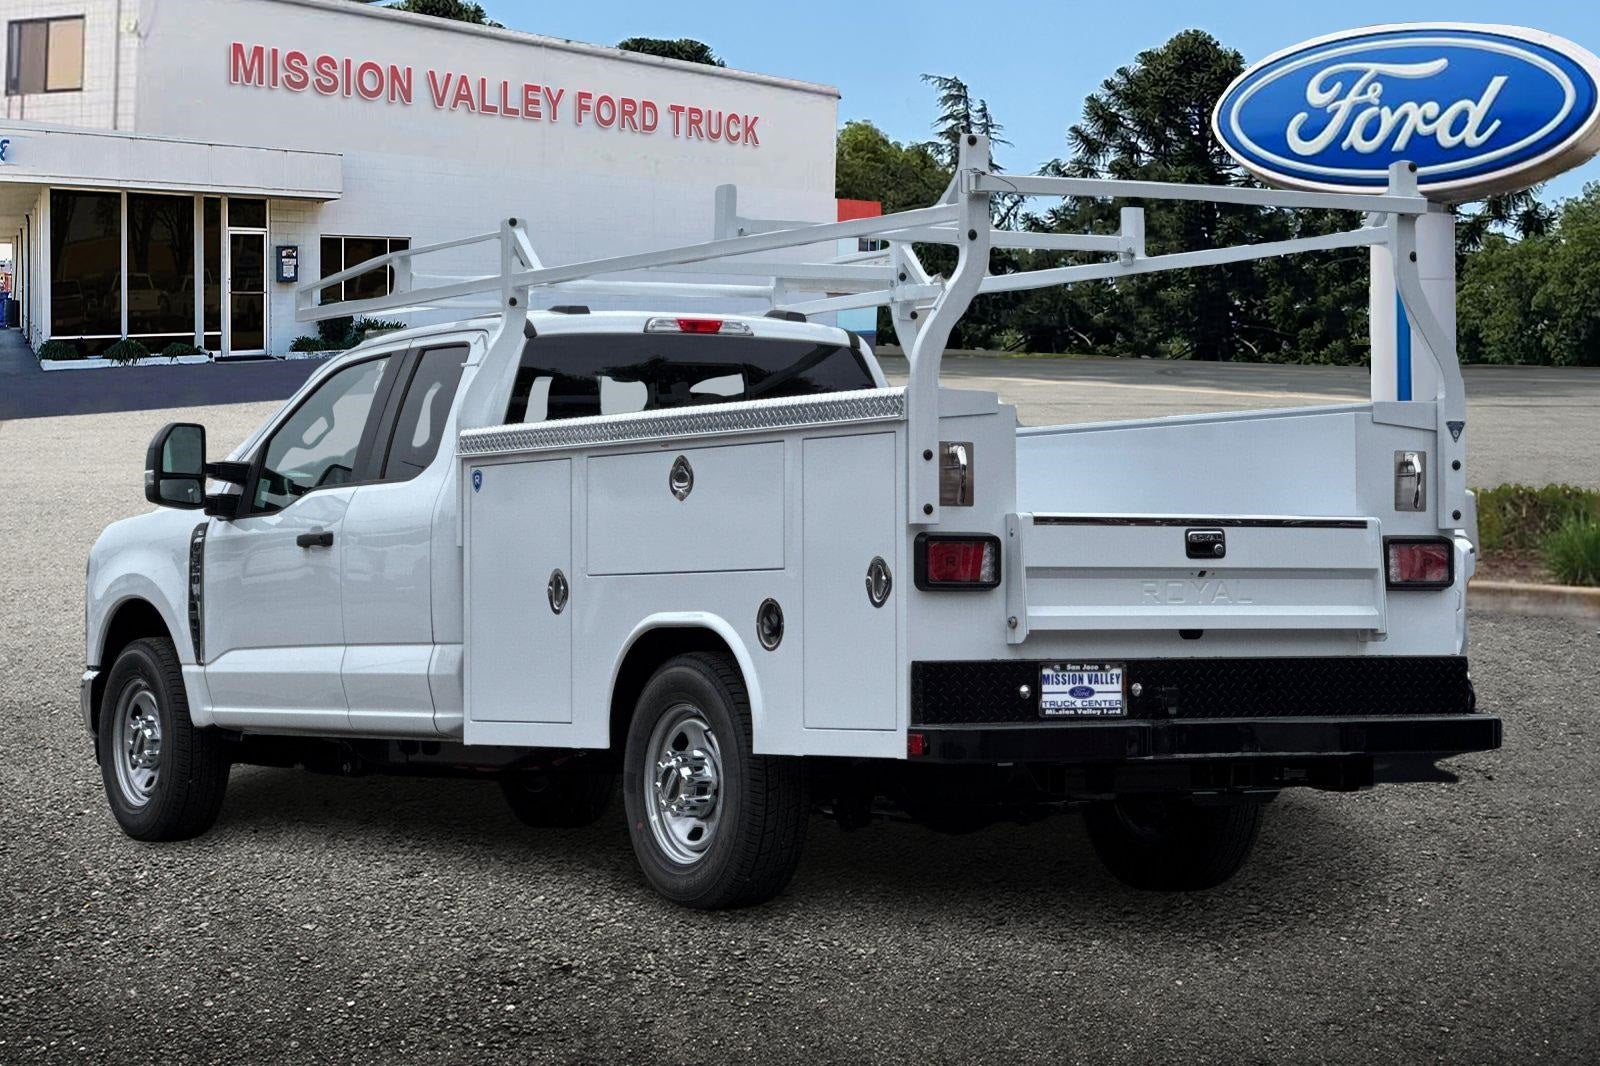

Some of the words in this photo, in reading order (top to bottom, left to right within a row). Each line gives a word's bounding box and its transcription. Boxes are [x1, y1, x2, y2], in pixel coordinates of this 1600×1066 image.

[229, 42, 413, 104] MISSION
[427, 70, 564, 122] VALLEY
[575, 91, 659, 134] FORD
[668, 104, 761, 147] TRUCK
[1286, 57, 1509, 156] Ford
[1140, 580, 1253, 604] ROYAL
[1042, 673, 1084, 685] MISSION
[1087, 673, 1121, 685] VALLEY
[1044, 700, 1077, 708] TRUCK
[1077, 708, 1101, 716] Valley
